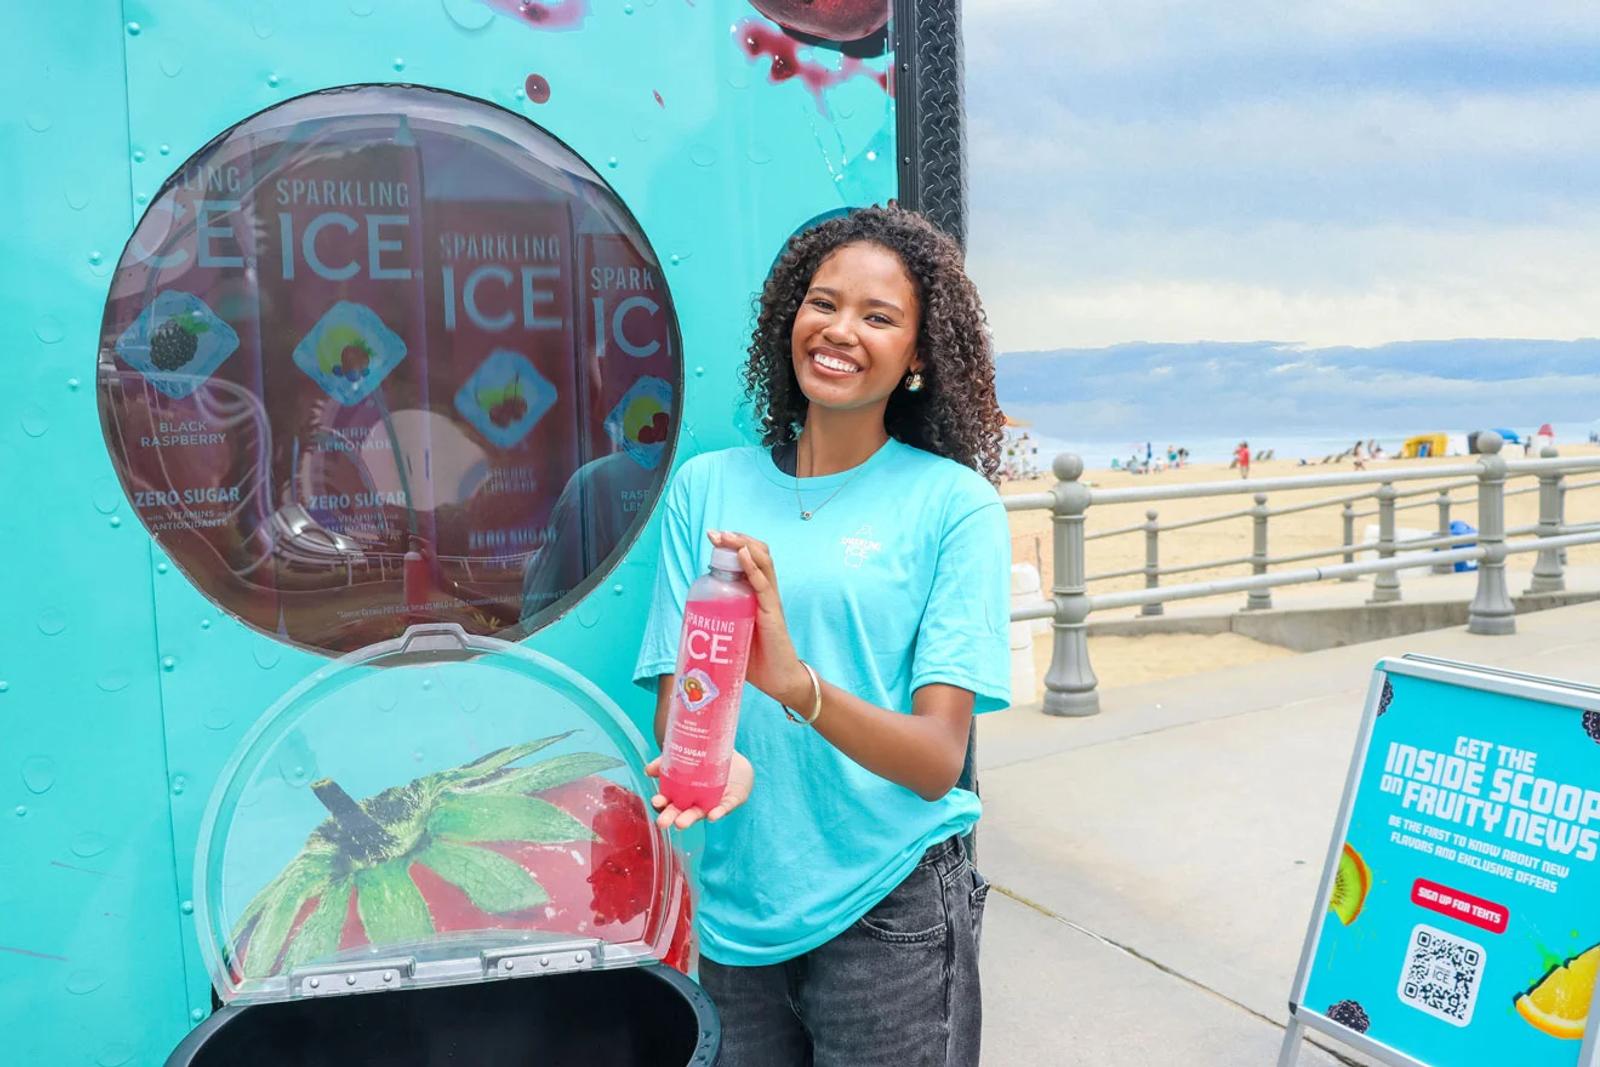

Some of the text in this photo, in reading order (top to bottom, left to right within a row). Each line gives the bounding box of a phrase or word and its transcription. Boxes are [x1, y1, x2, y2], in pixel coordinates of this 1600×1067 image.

[276, 179, 409, 207] SPARKLING
[278, 211, 412, 281] ICE
[440, 233, 561, 261] SPARKLING
[442, 264, 563, 331] ICE
[592, 295, 672, 358] IC
[141, 433, 227, 448] RASPBERRY
[159, 421, 207, 433] BLACK
[134, 487, 241, 507] ZERO SUGAR
[308, 490, 407, 512] ZERO SUGAR
[1454, 735, 1538, 773] GET THE
[1384, 741, 1600, 826] INSIDE SCOOP
[1379, 774, 1600, 862] ON FRUITY NEWS
[1388, 814, 1570, 879] BE THE FIRST TO KNOW ABOUT NEW
[1390, 831, 1559, 894] FLAVORS AND EXCLUSIVE OFFERS
[1417, 886, 1502, 924] SIGN UP FOR TEXTS
